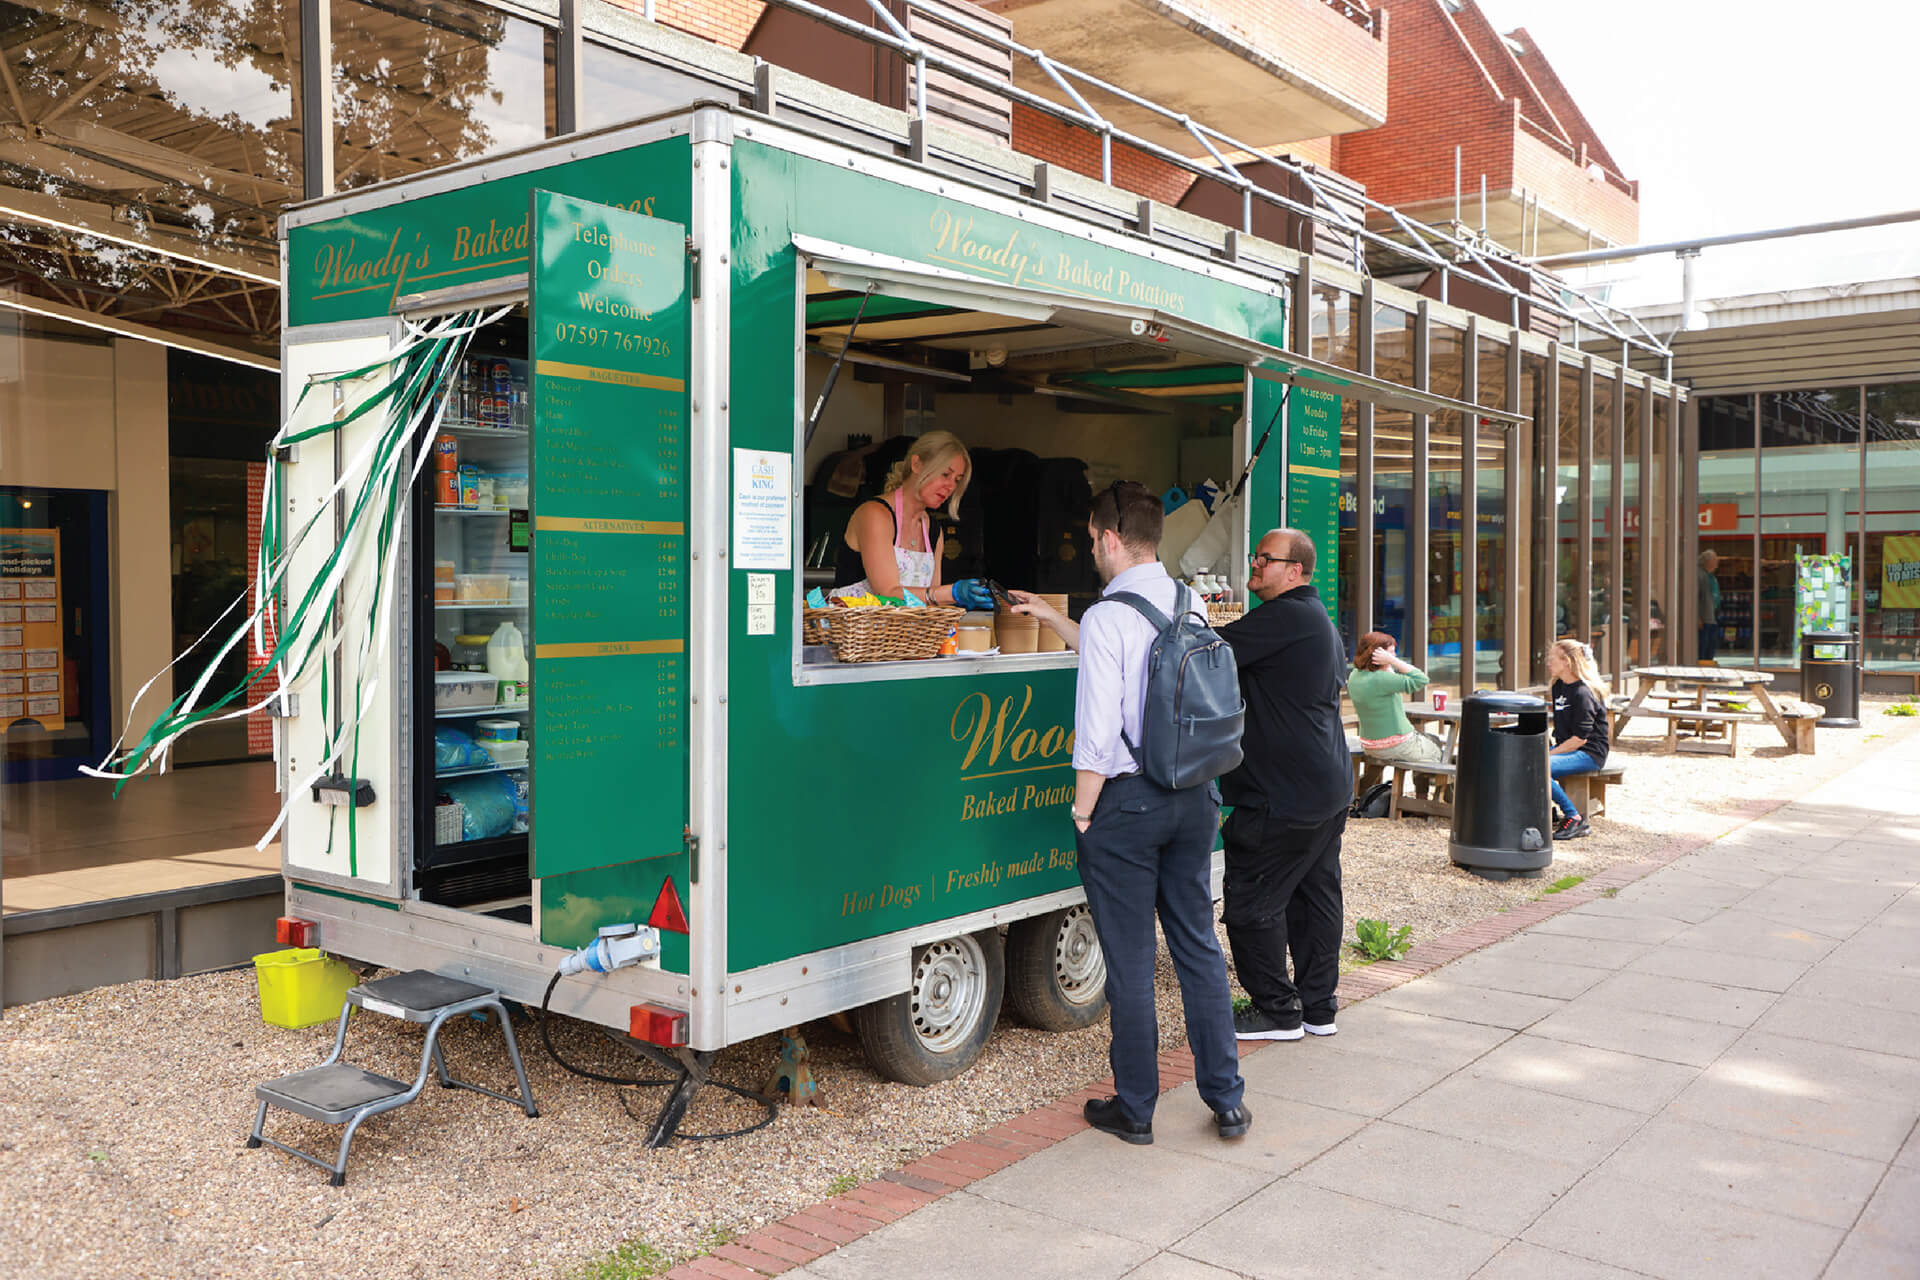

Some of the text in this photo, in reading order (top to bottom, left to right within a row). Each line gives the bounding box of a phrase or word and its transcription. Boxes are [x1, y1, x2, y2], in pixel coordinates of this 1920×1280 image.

[571, 221, 656, 257] Telephone
[314, 212, 528, 315] Woody's Baked
[929, 208, 1185, 313] Woody's Baked Potatoes
[587, 259, 644, 287] Orders
[577, 291, 654, 322] Welcome
[556, 322, 671, 357] 07597 767926
[1304, 404, 1328, 421] Monday
[1310, 424, 1328, 440] Friday
[751, 464, 775, 475] CASH
[751, 479, 774, 489] KING
[583, 520, 646, 532] ALTERNATIVES
[0, 558, 52, 567] and-picked
[2, 566, 42, 575] holidays
[1902, 570, 1920, 580] MIS
[597, 643, 631, 654] DRINKS
[960, 787, 1018, 822] Baked
[841, 890, 874, 917] Hot
[879, 882, 922, 909] Dogs
[945, 861, 1003, 894] Freshly
[1007, 851, 1045, 879] made
